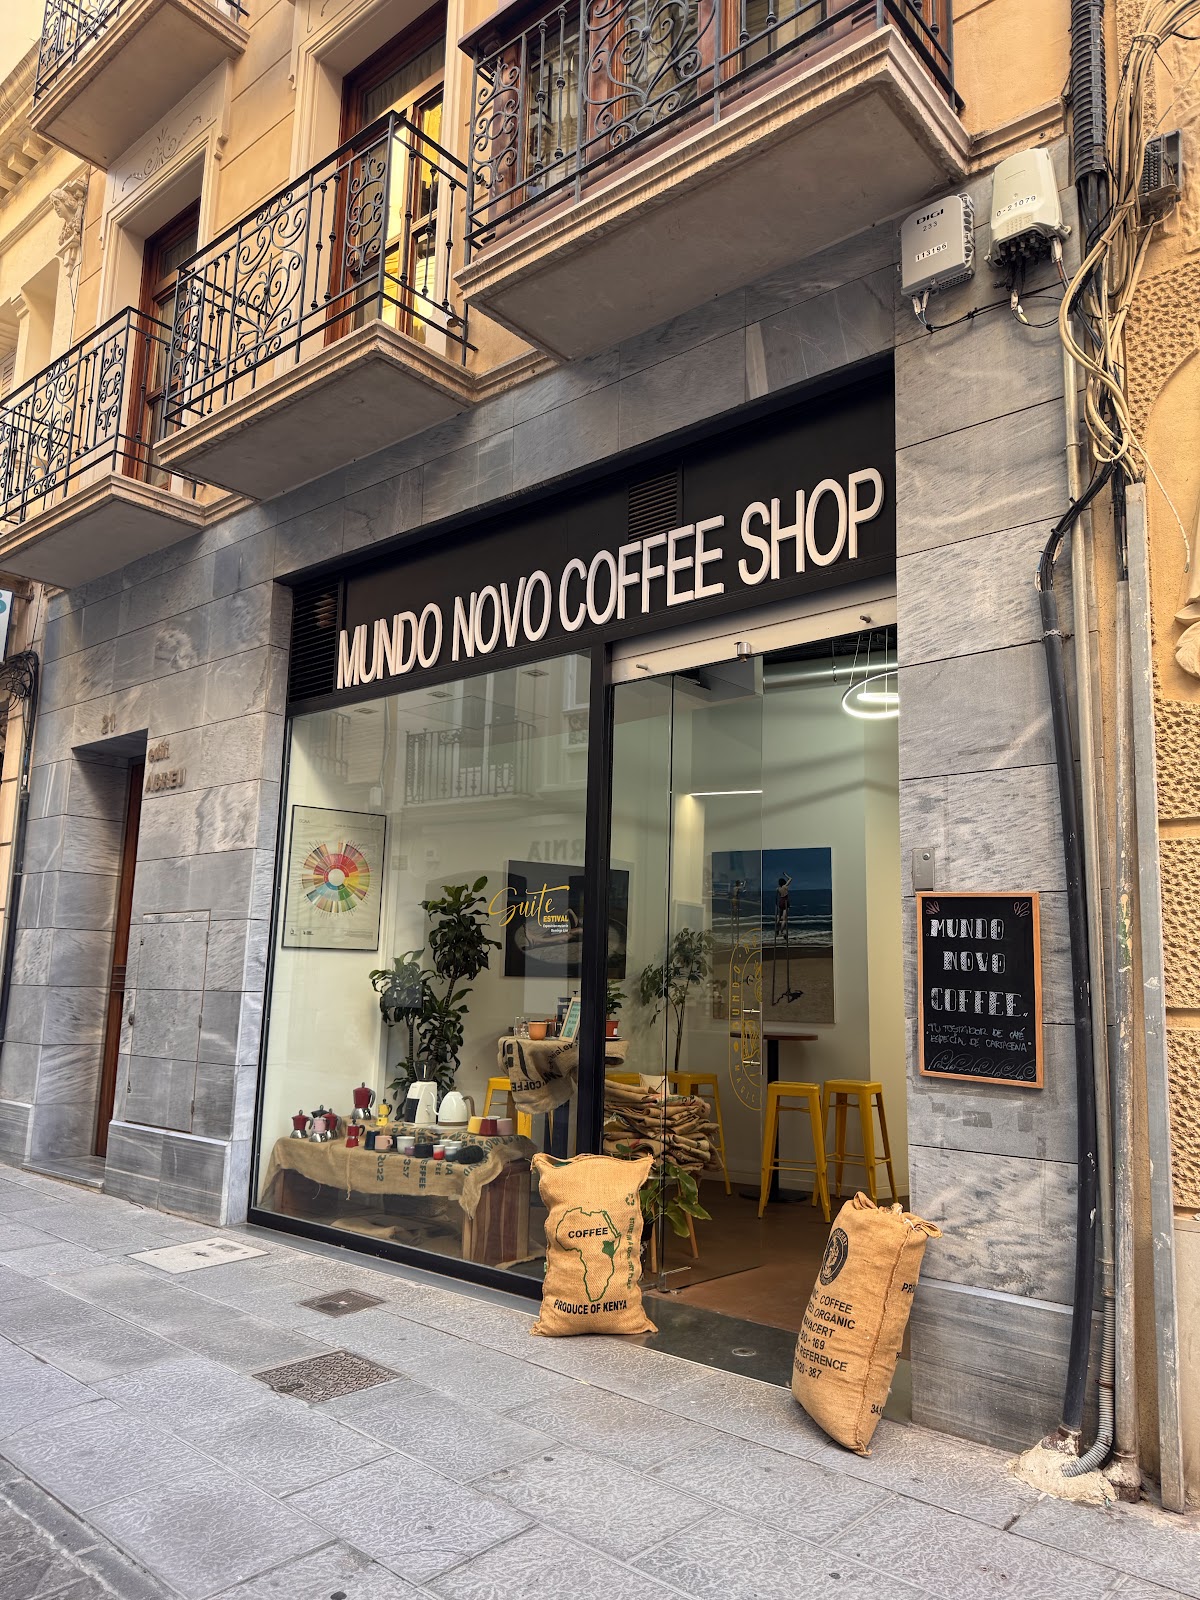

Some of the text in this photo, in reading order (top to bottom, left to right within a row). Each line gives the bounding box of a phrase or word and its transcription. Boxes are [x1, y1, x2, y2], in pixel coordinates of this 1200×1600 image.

[916, 209, 944, 225] DIGI
[336, 467, 885, 690] MUNDO NOVO COFFEE SHOP
[487, 883, 570, 927] Suite
[543, 915, 569, 923] ESTIVAL
[930, 918, 1005, 940] MUNDO
[942, 951, 1006, 974] NOVO
[928, 1023, 940, 1033] TU
[992, 1028, 1003, 1038] DE
[568, 1227, 609, 1239] COFFEE
[553, 1299, 627, 1315] PRODUCE OF KENYA
[819, 1295, 853, 1314] COFFEE
[814, 1308, 856, 1330] ORGANIC
[800, 1345, 849, 1372] REFERENCE
